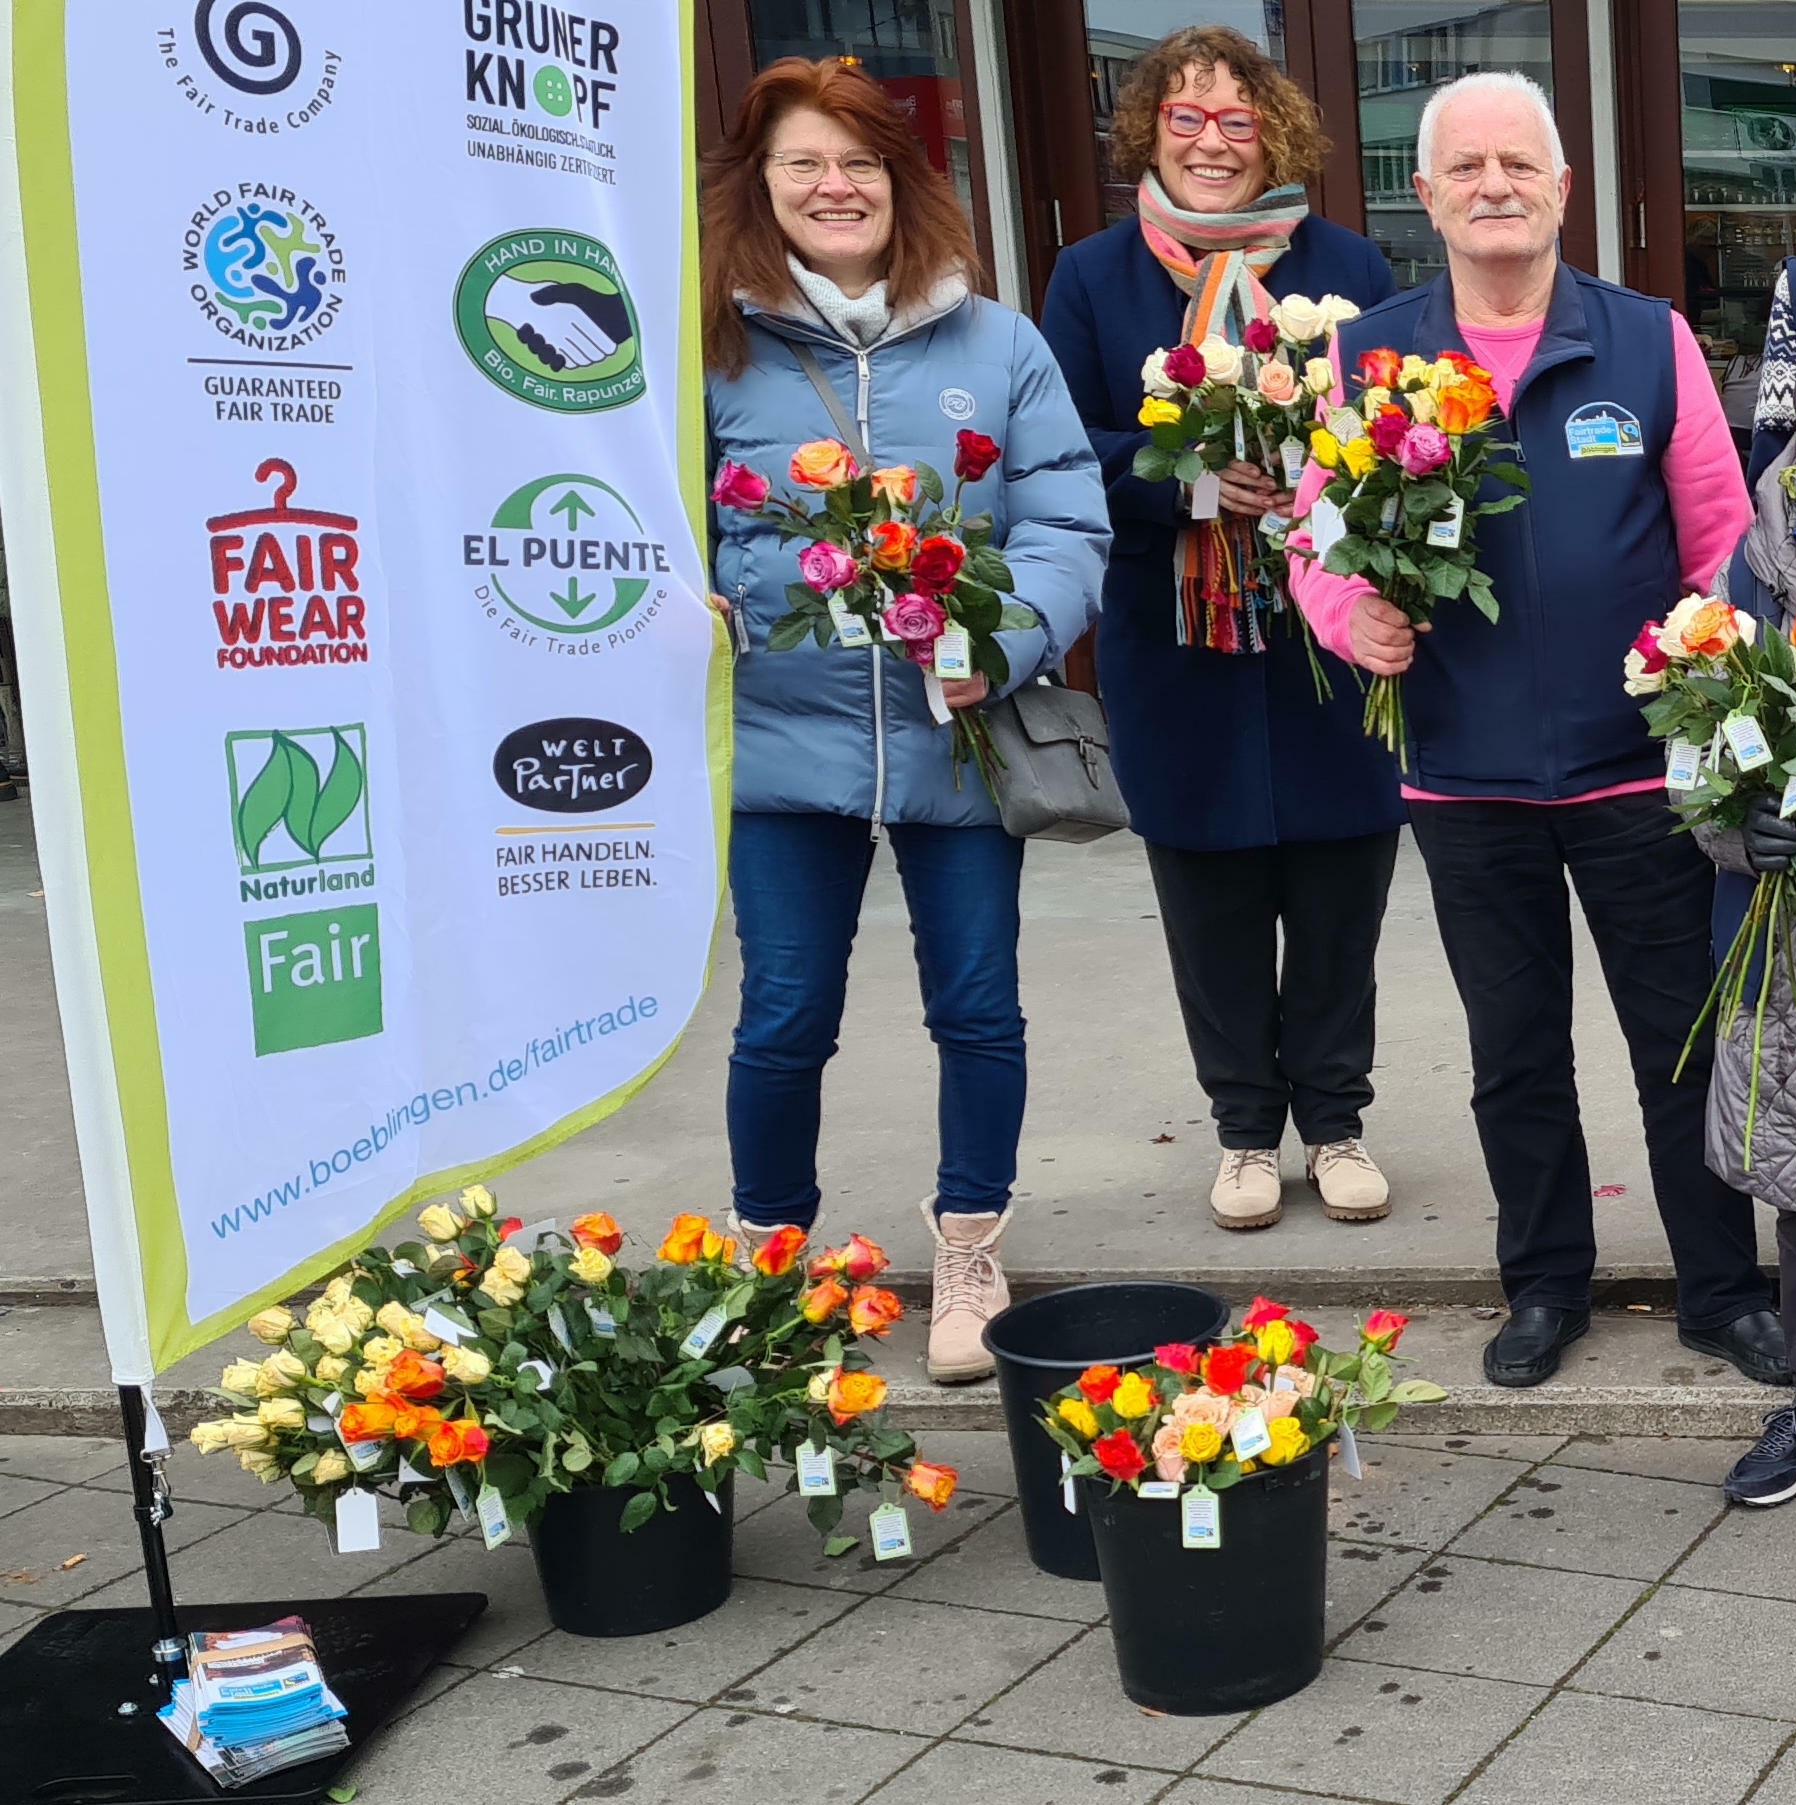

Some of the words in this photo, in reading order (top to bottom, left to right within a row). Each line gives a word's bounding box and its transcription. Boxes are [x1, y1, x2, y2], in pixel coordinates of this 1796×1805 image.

[157, 28, 178, 69] The
[176, 75, 216, 114] Fair
[223, 109, 280, 134] Trade
[287, 50, 342, 129] Company
[467, 140, 557, 170] UNABHÄNGIG
[182, 189, 232, 271] WORLD
[238, 182, 296, 207] FAIR
[300, 200, 346, 283] TRADE
[484, 239, 545, 273] HAND
[554, 239, 577, 256] IN
[190, 284, 343, 351] ORGANIZATION
[204, 376, 342, 400] GUARANTEED
[484, 350, 516, 383] Bio.
[523, 376, 559, 400] Fair.
[215, 401, 263, 421] FAIR
[270, 402, 335, 424] TRADE
[210, 532, 359, 594] FAIR
[463, 535, 509, 566] EL
[523, 537, 670, 573] PUENTE
[213, 595, 365, 646] WEAR
[474, 585, 497, 618] Die
[499, 617, 538, 646] Fair
[547, 637, 601, 655] Trade
[607, 588, 667, 649] Pioniere
[217, 642, 368, 669] FOUNDATION
[541, 739, 626, 757] WELT
[496, 845, 535, 868] FAIR
[541, 840, 655, 863] HANDELN.
[240, 863, 375, 903] Naturland
[498, 870, 570, 896] BESSER
[580, 867, 658, 889] LEBEN.
[260, 922, 371, 993] Fair
[210, 995, 659, 1241] www.boeblingen.de/fairtrade
